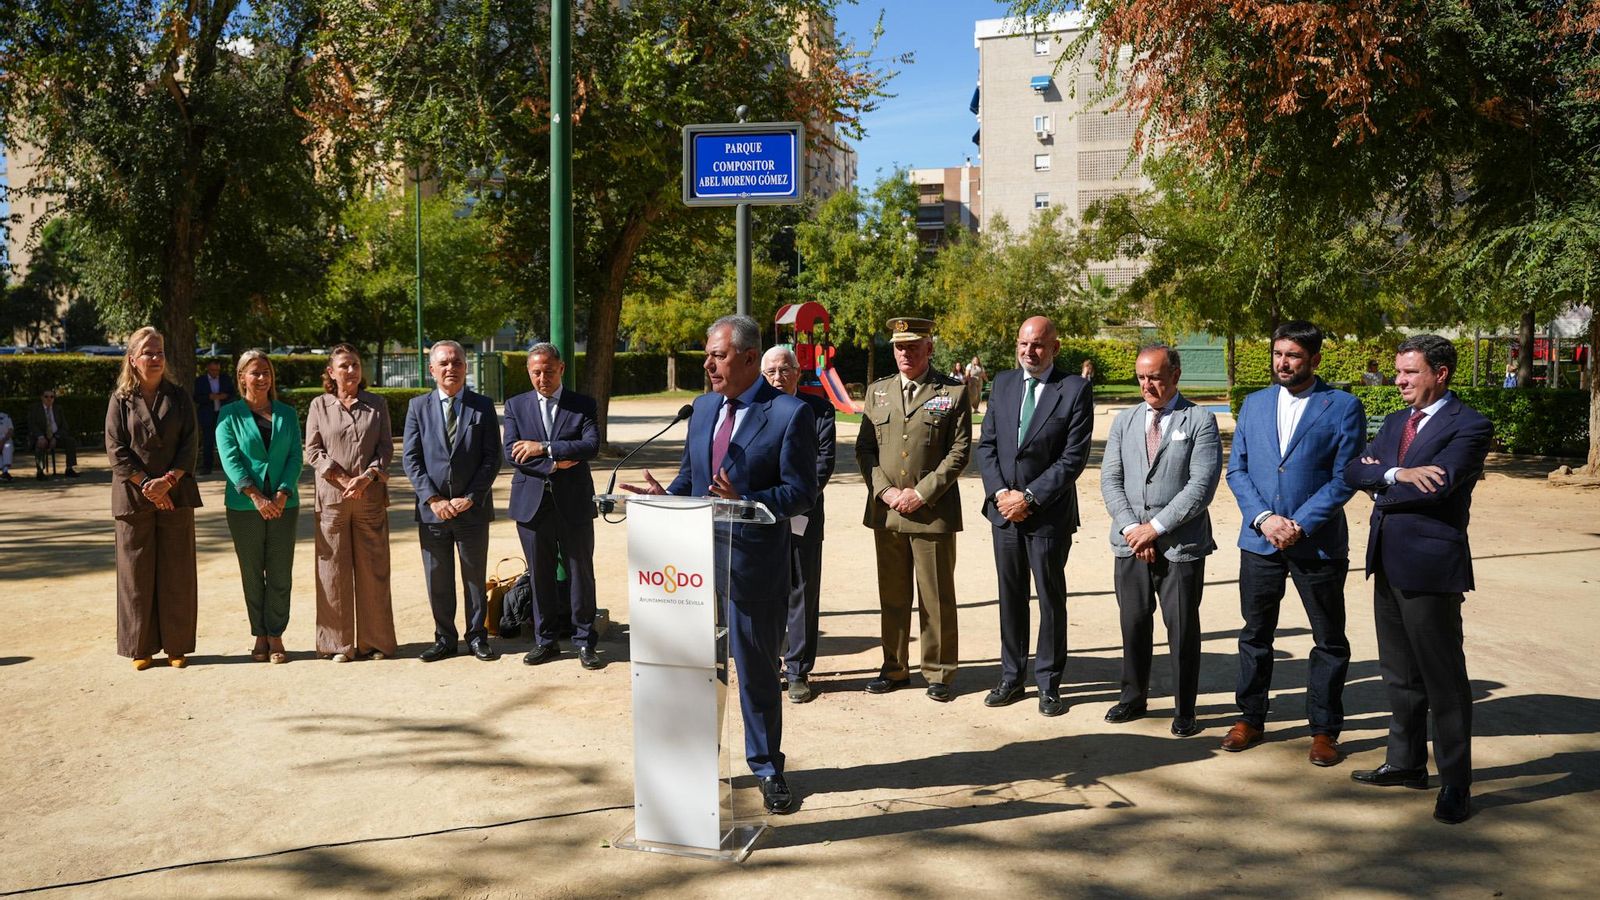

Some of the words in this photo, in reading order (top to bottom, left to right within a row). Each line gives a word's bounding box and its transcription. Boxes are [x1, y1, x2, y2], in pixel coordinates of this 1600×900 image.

[725, 142, 762, 155] PARQUE
[713, 160, 775, 172] COMPOSITOR
[699, 176, 720, 187] ABEL
[721, 175, 757, 186] MORENO
[758, 172, 788, 185] GÓMEZ
